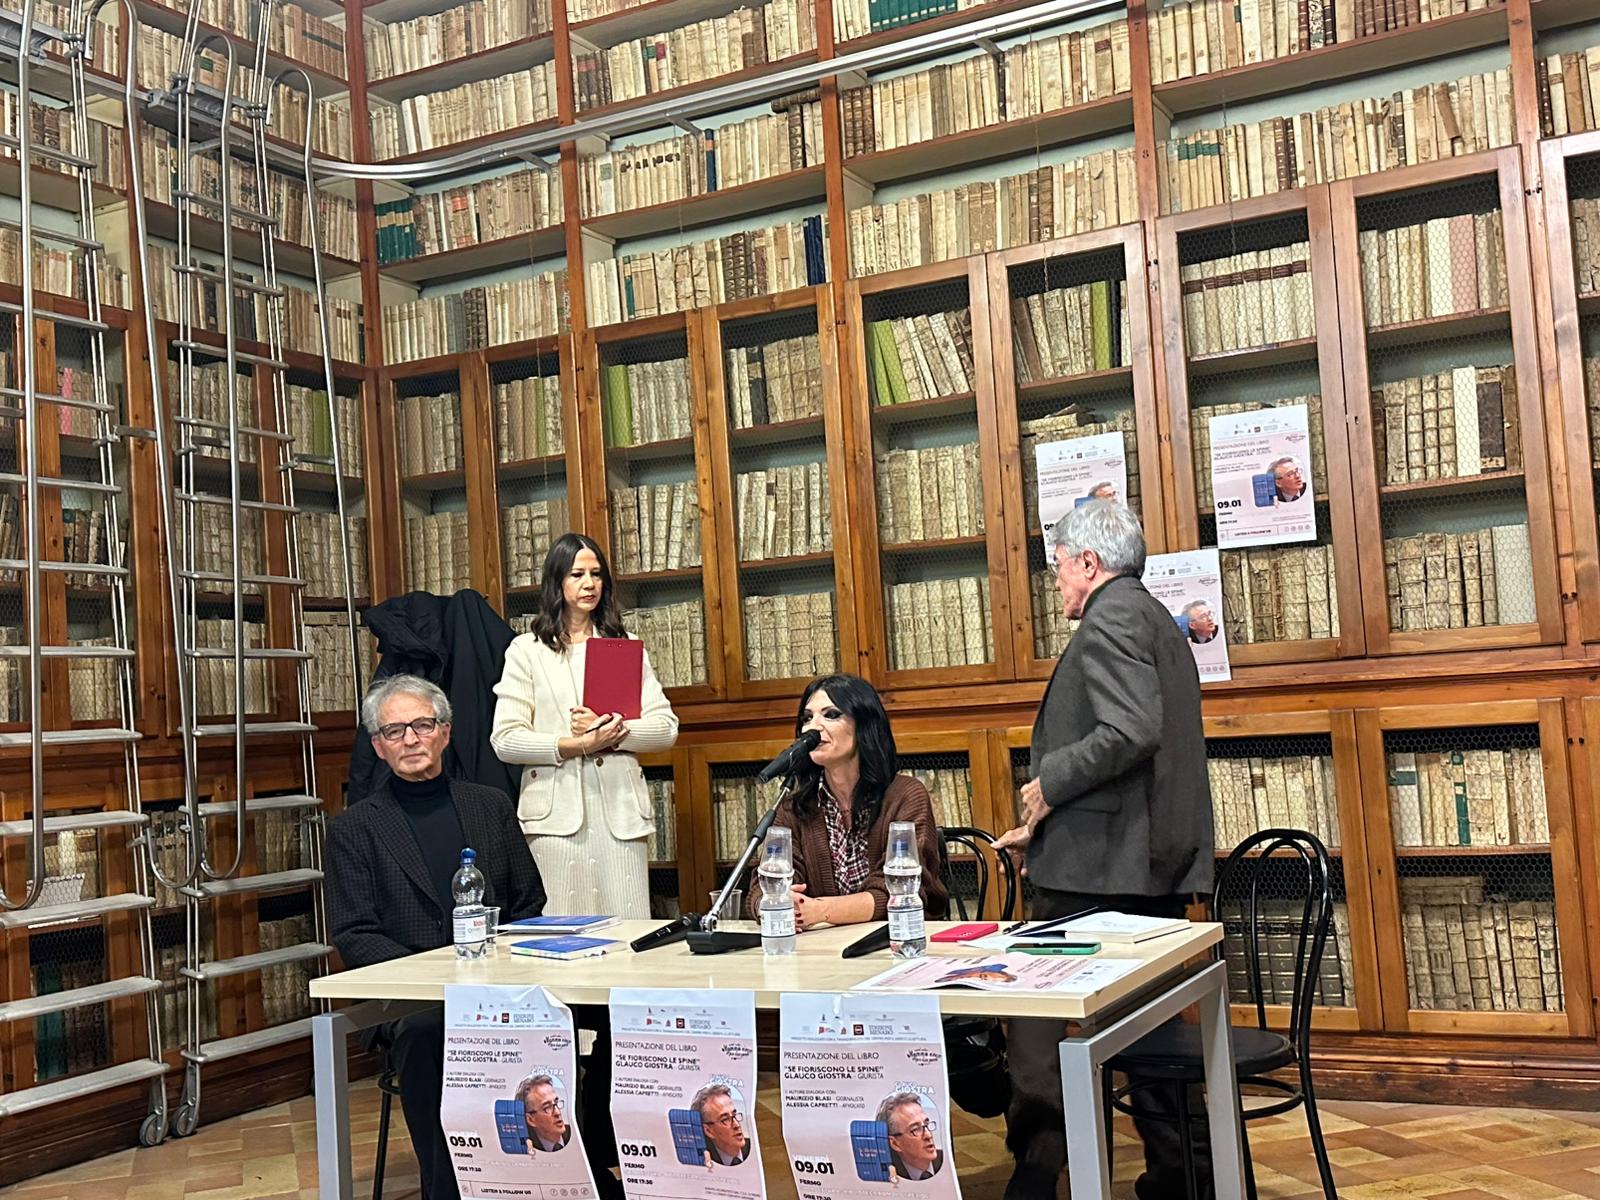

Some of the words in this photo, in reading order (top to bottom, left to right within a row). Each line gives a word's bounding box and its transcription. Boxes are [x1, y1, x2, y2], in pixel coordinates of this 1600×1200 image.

[1218, 500, 1242, 508] 09.01
[615, 1041, 664, 1050] PRESENTAZIONE
[784, 1052, 840, 1060] PRESENTAZIONE
[450, 1136, 483, 1148] 09.01
[621, 1144, 657, 1157] 09.01
[795, 1160, 834, 1174] 09.01
